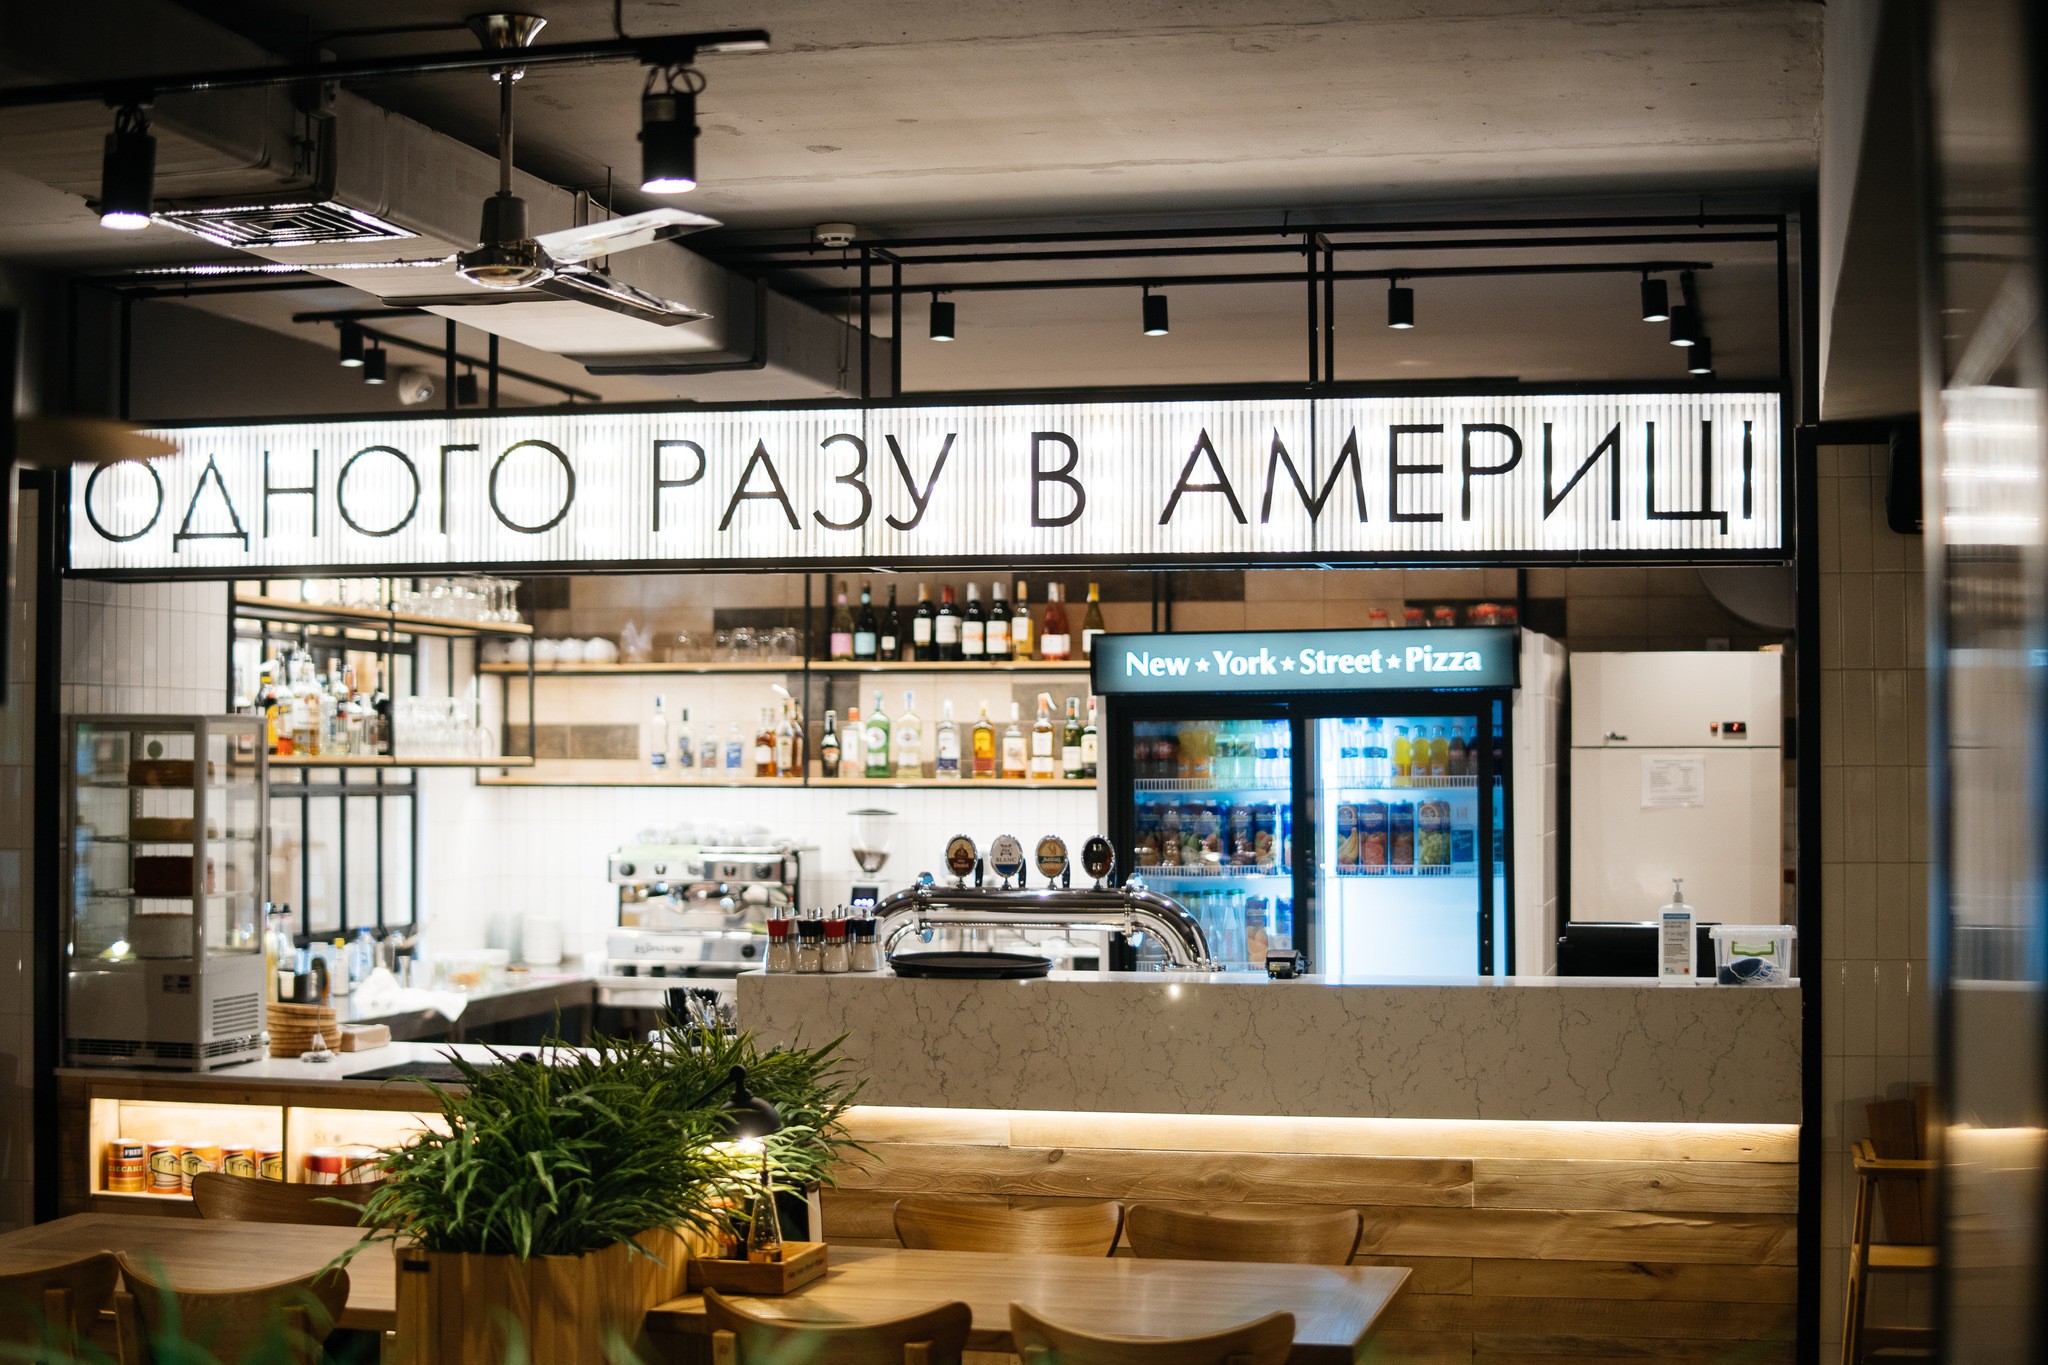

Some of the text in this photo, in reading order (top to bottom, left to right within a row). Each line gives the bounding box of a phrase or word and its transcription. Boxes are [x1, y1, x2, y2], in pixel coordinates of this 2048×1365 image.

[84, 419, 1753, 553] ОДНОГО РАЗУ В АМЕРИЦІ
[1126, 644, 1483, 677] New York Street Pizza
